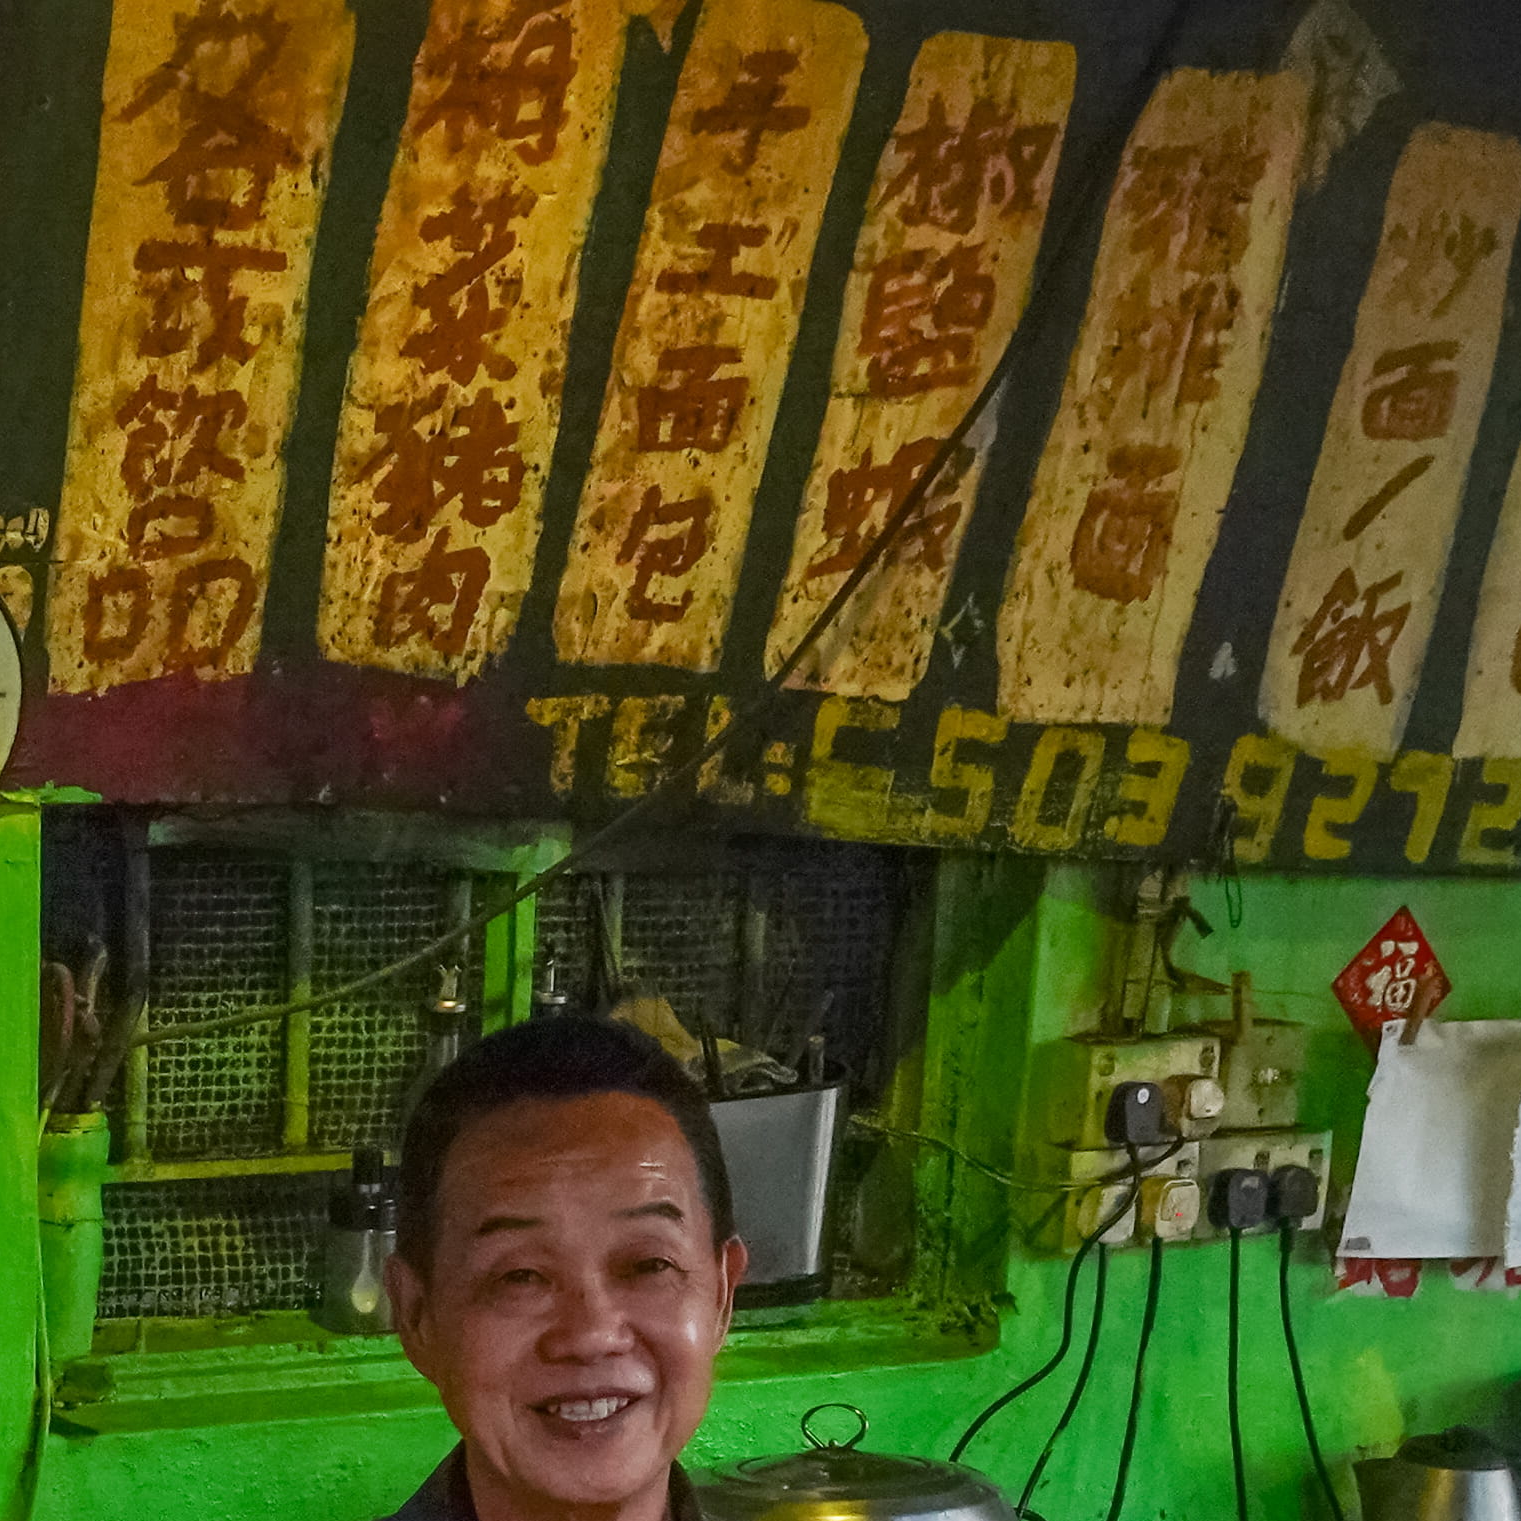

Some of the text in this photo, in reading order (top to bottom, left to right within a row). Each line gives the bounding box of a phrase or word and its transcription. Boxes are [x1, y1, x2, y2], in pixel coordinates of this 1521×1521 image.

[616, 50, 810, 622] 手工面包
[1366, 940, 1420, 1011] 福
